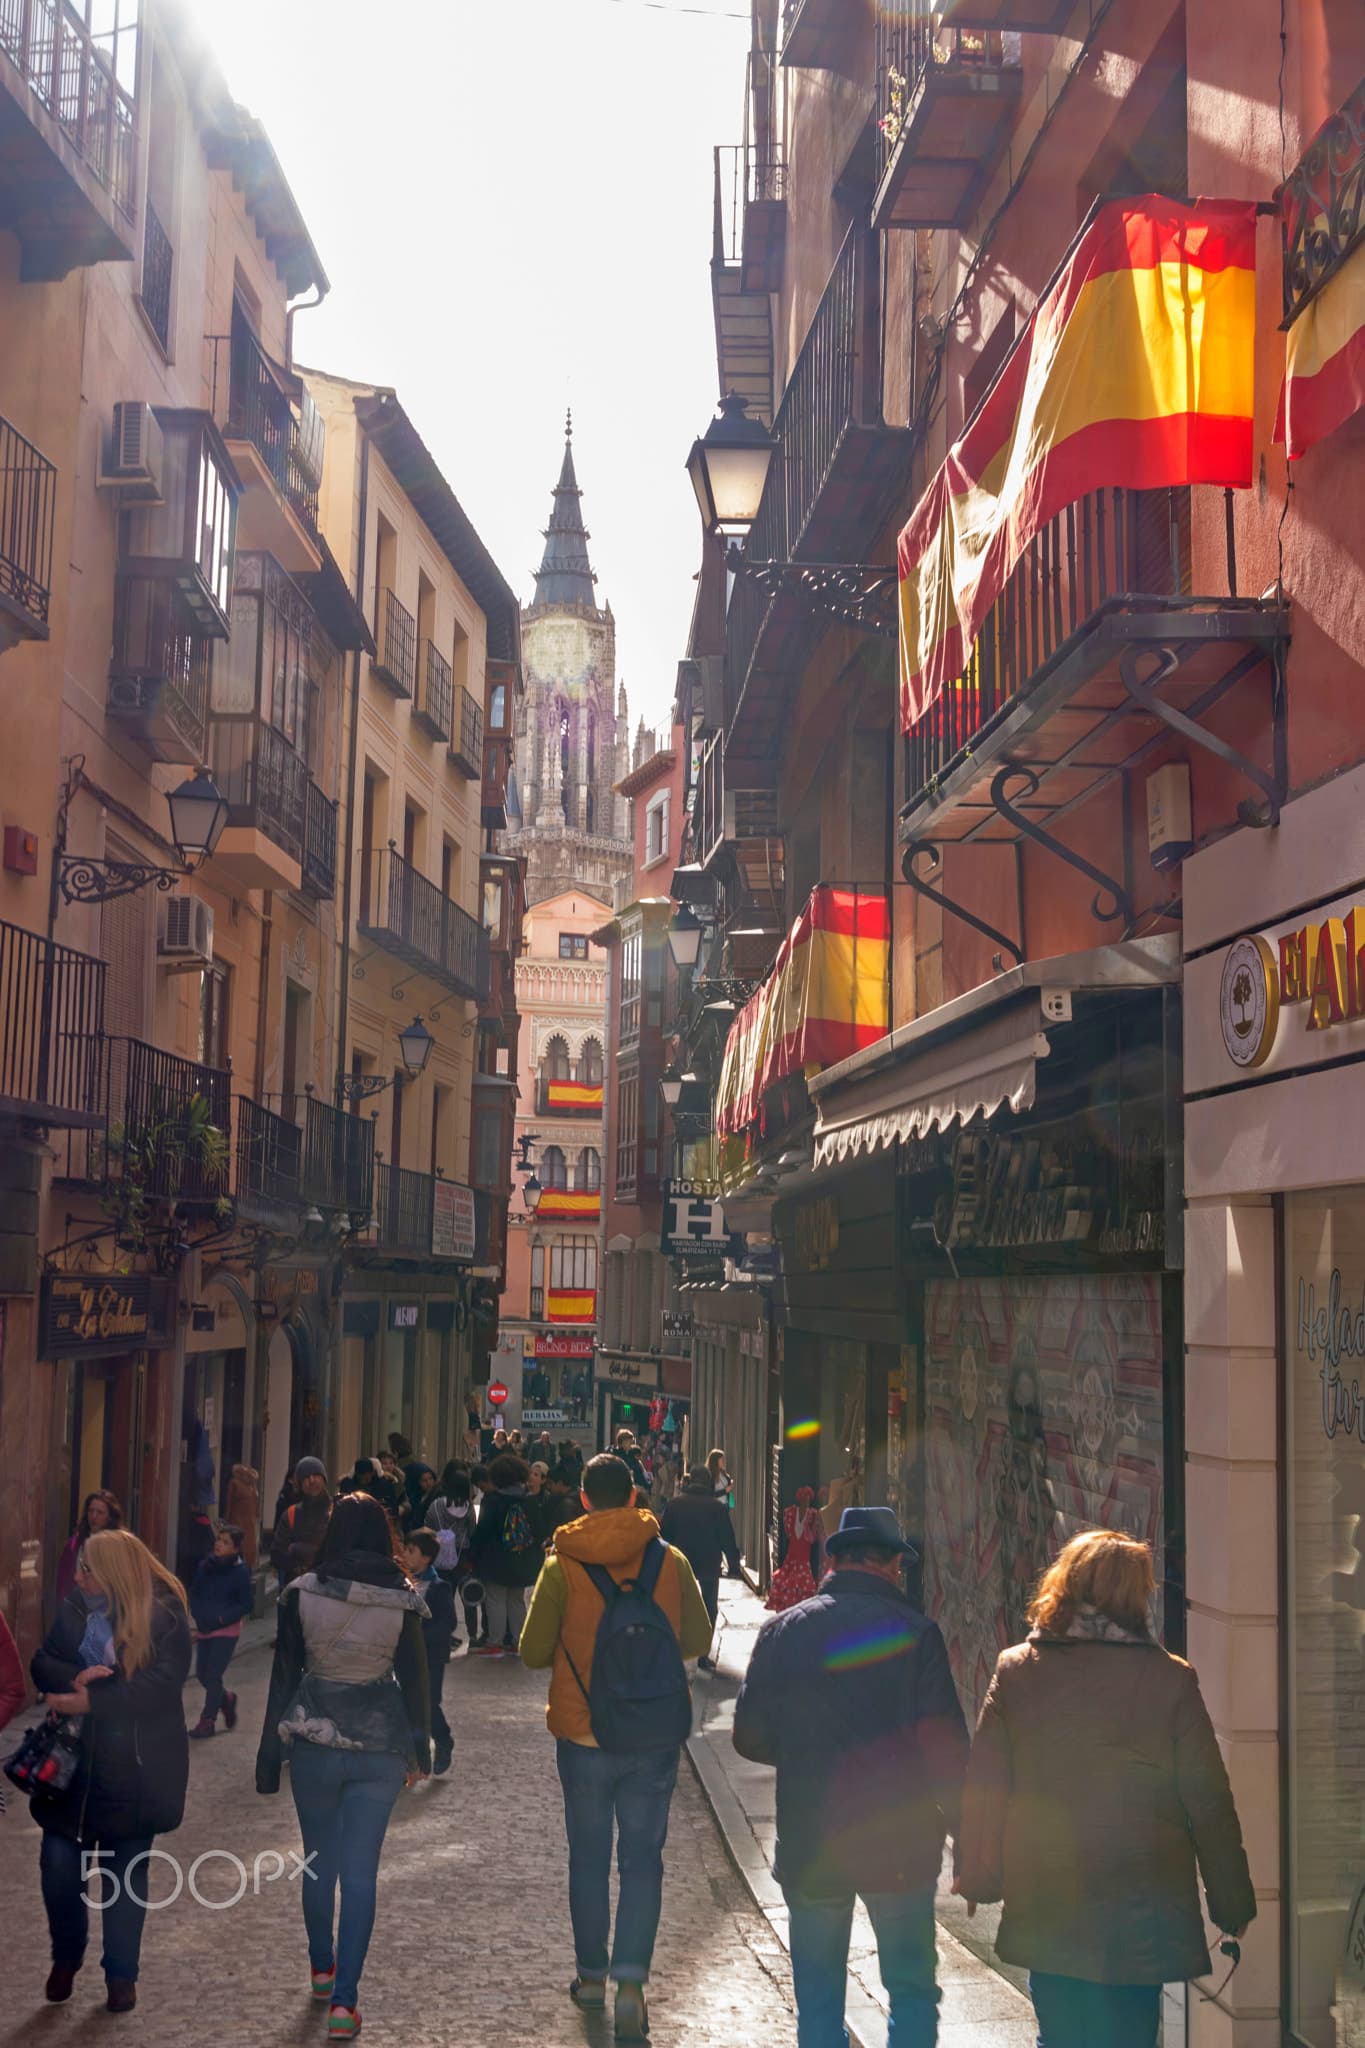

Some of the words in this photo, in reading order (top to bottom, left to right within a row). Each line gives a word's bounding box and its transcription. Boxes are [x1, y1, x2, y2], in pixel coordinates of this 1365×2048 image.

[667, 1197, 731, 1241] H
[664, 1328, 691, 1337] ROMA
[523, 1412, 560, 1420] REBAJAS
